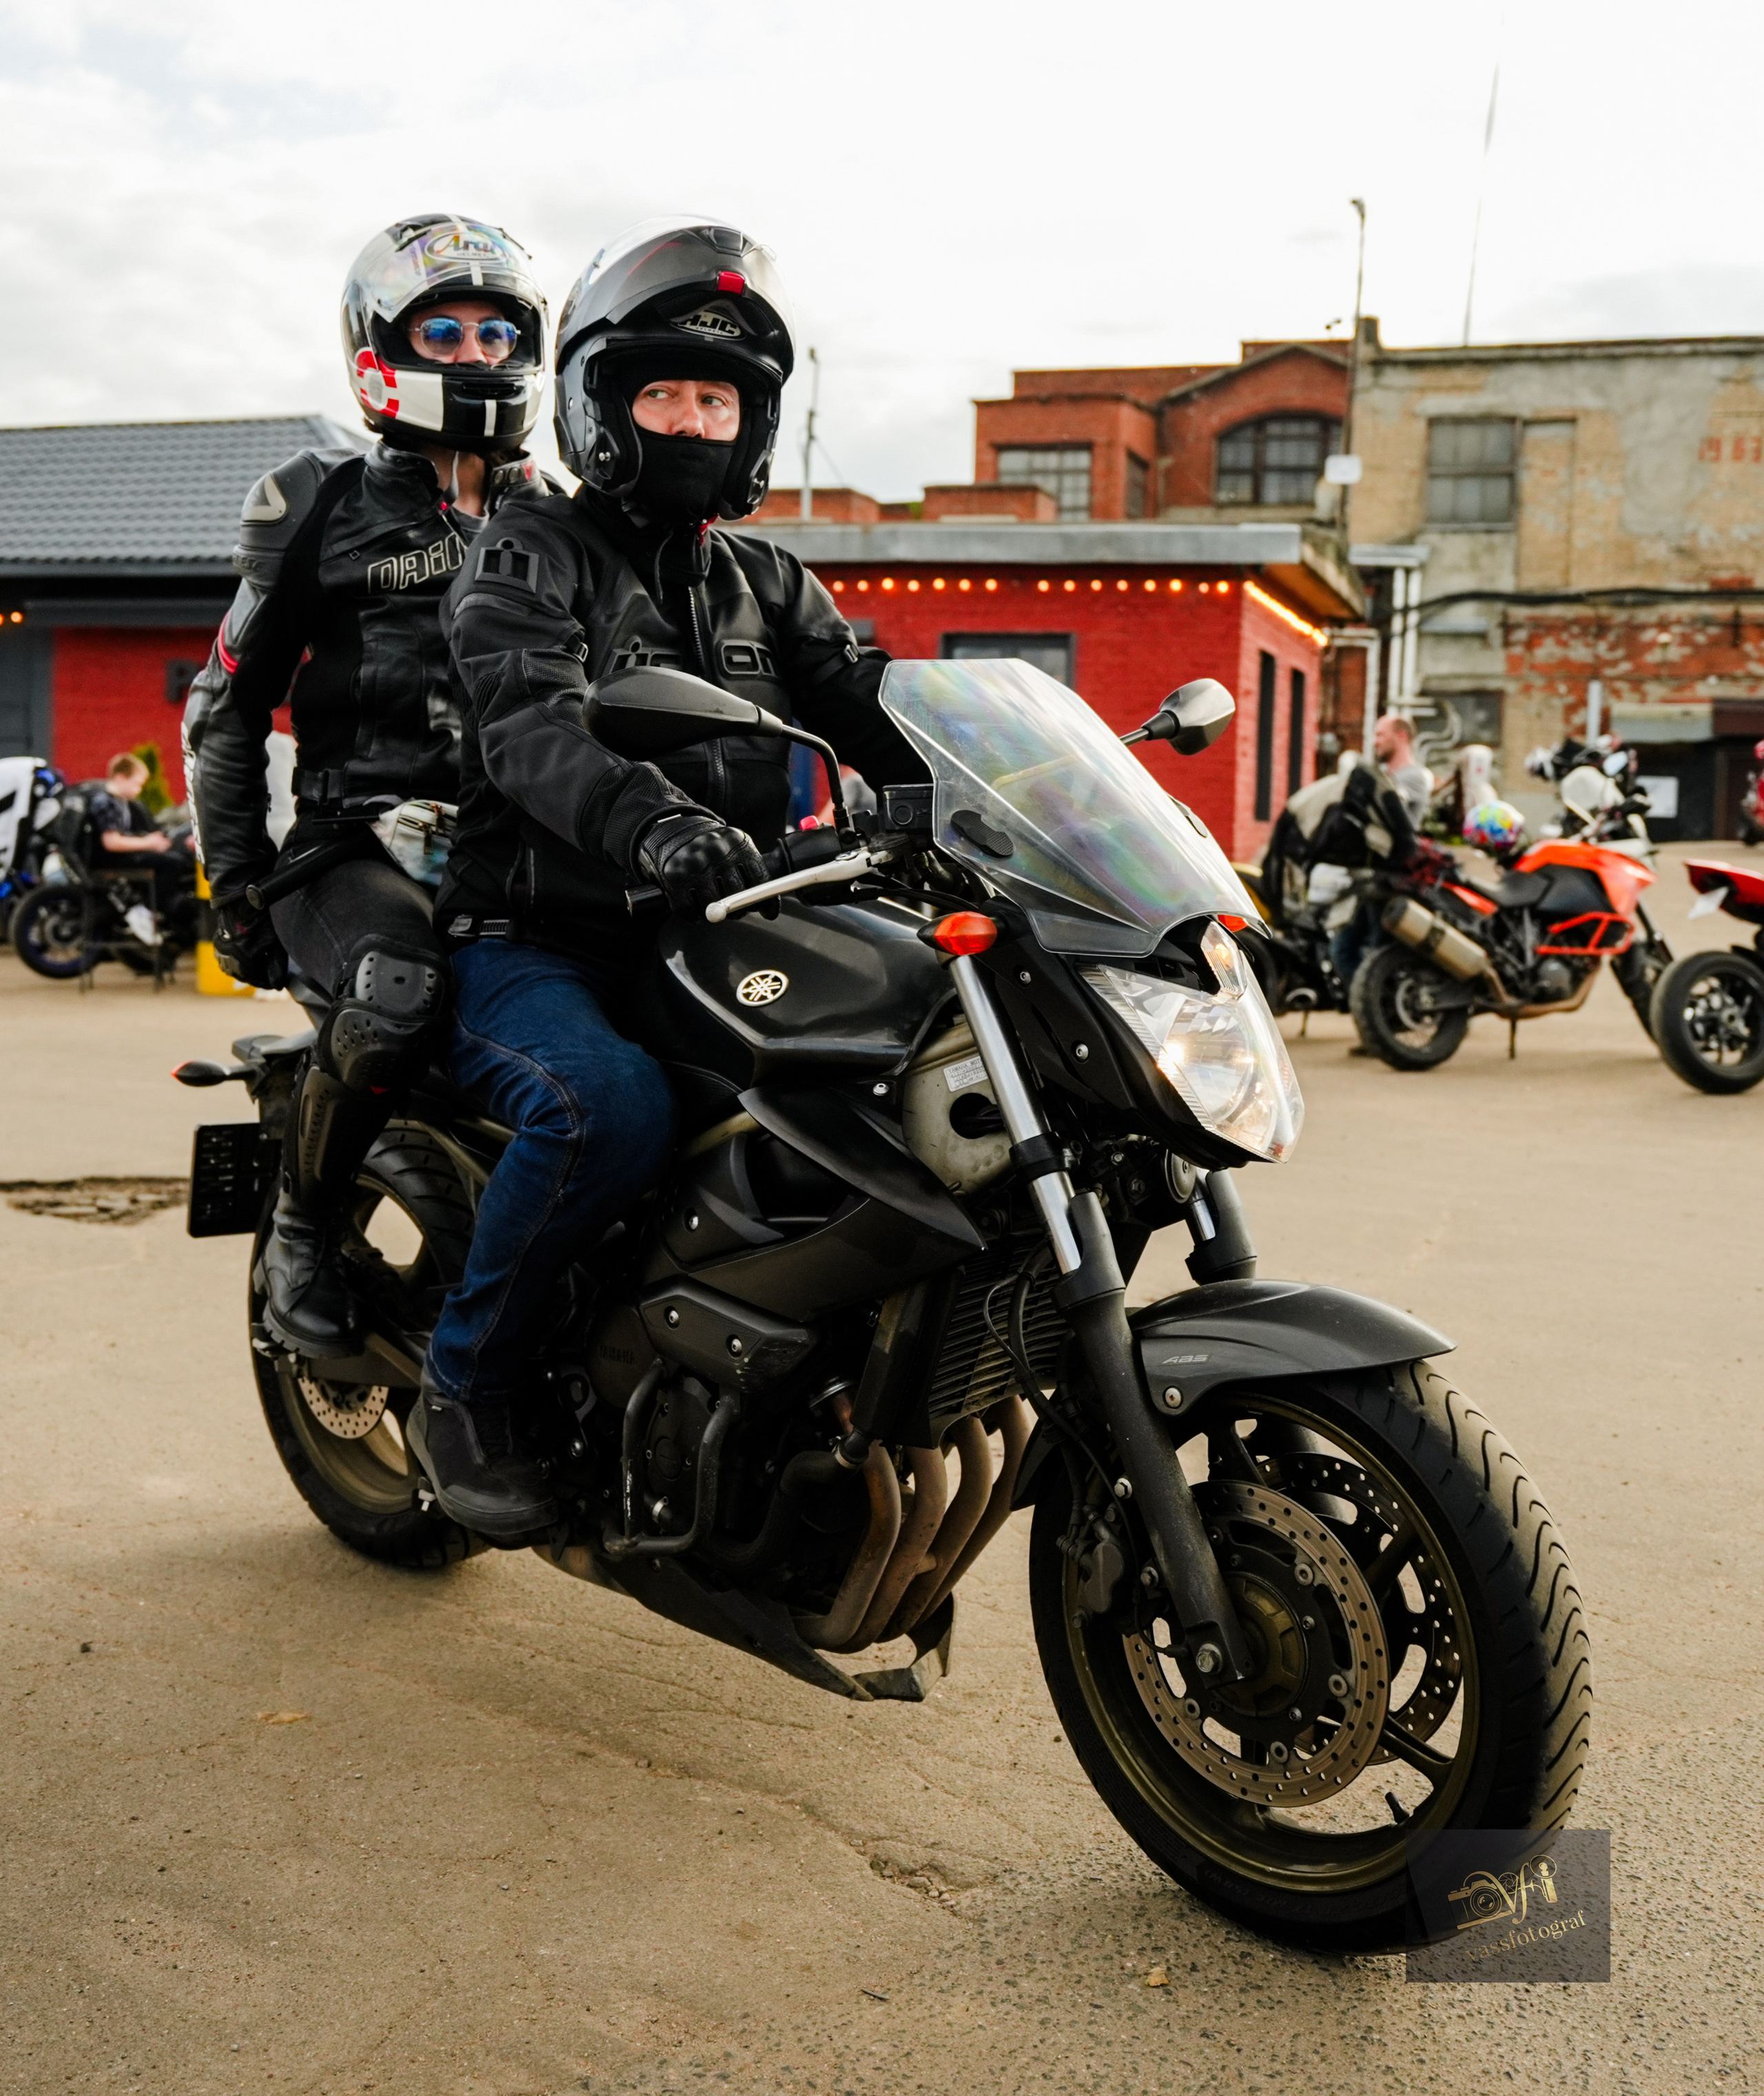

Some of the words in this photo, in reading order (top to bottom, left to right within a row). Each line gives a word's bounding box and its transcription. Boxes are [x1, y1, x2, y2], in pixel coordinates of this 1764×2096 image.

[679, 314, 738, 335] HJC
[695, 327, 724, 335] HELMETS
[947, 1064, 969, 1073] YAMAHA
[599, 1344, 635, 1365] YAMAHA
[1162, 1354, 1209, 1364] ABS
